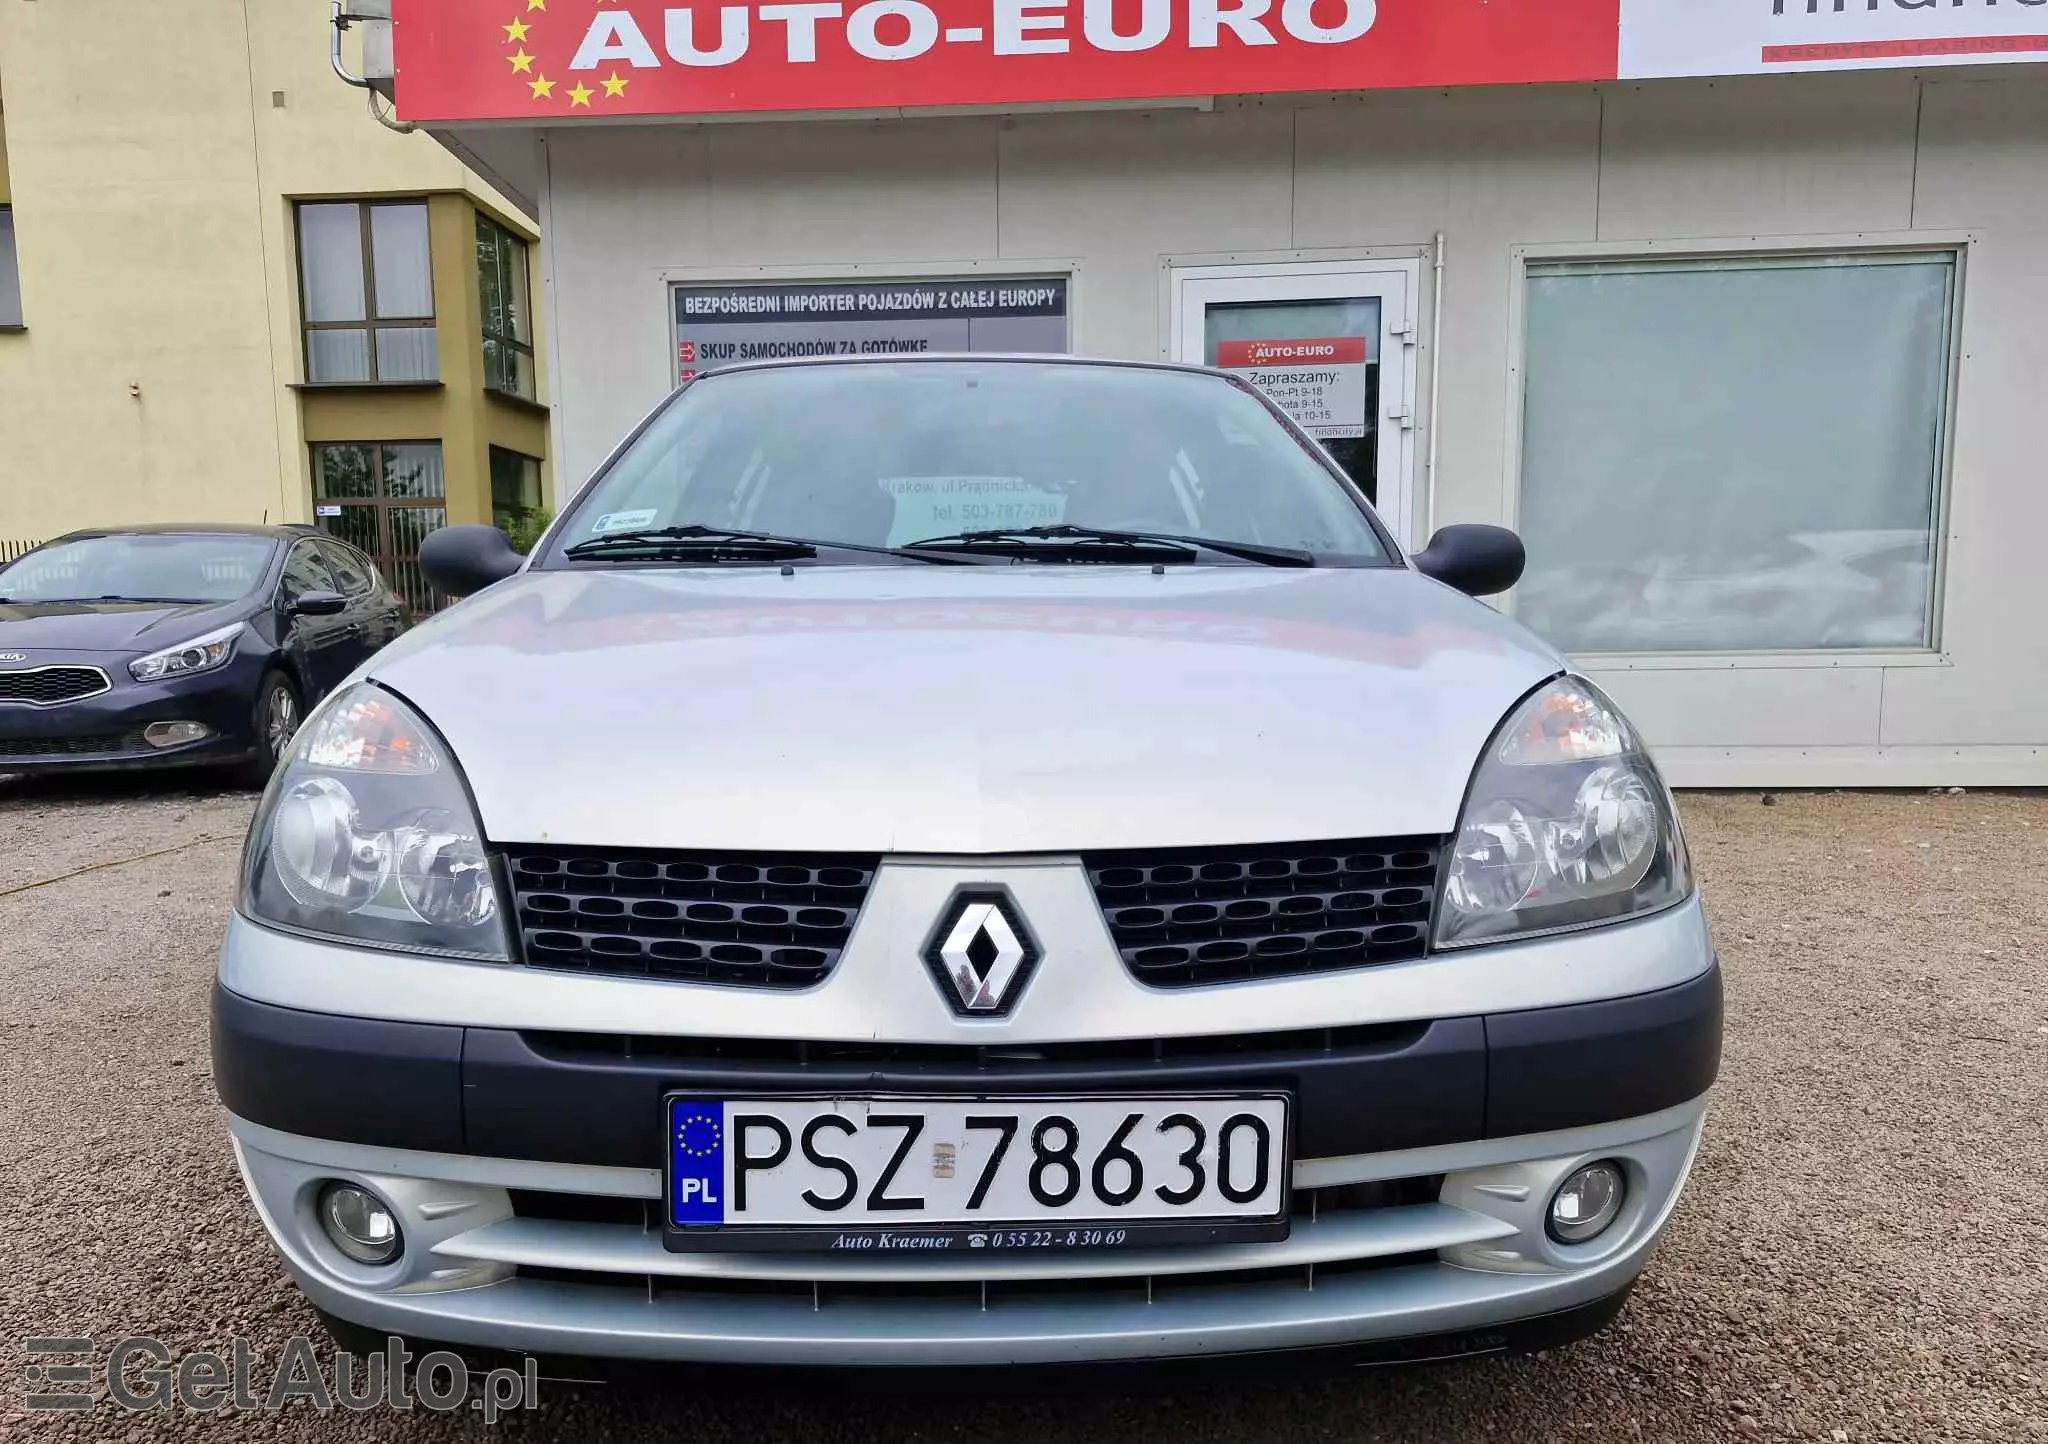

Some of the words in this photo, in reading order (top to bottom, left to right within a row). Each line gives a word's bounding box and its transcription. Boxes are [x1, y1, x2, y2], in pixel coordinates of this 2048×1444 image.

[568, 0, 1378, 70] AUTO-EURO
[685, 292, 780, 314] BEZPOŚREDNI
[785, 294, 855, 312] IMPORTER
[858, 289, 935, 311] POJAZDÓW
[938, 293, 948, 309] Z
[951, 291, 995, 309] CAŁEJ
[999, 289, 1056, 308] EUROPY
[700, 343, 736, 359] SKUP
[740, 338, 836, 359] SAMOCHODÓW
[840, 341, 857, 354] ZA
[1256, 345, 1334, 358] AUTO-EURO
[1250, 371, 1340, 386] Zapraszamy:
[1301, 386, 1323, 397] 9-18
[1302, 398, 1323, 409] 9-15
[1305, 410, 1332, 421] 10-15
[732, 1112, 925, 1212] PSZ
[964, 1112, 1271, 1210] 78630
[682, 1177, 717, 1204] PL
[831, 1233, 873, 1249] Auto
[878, 1232, 954, 1249] Kraemer
